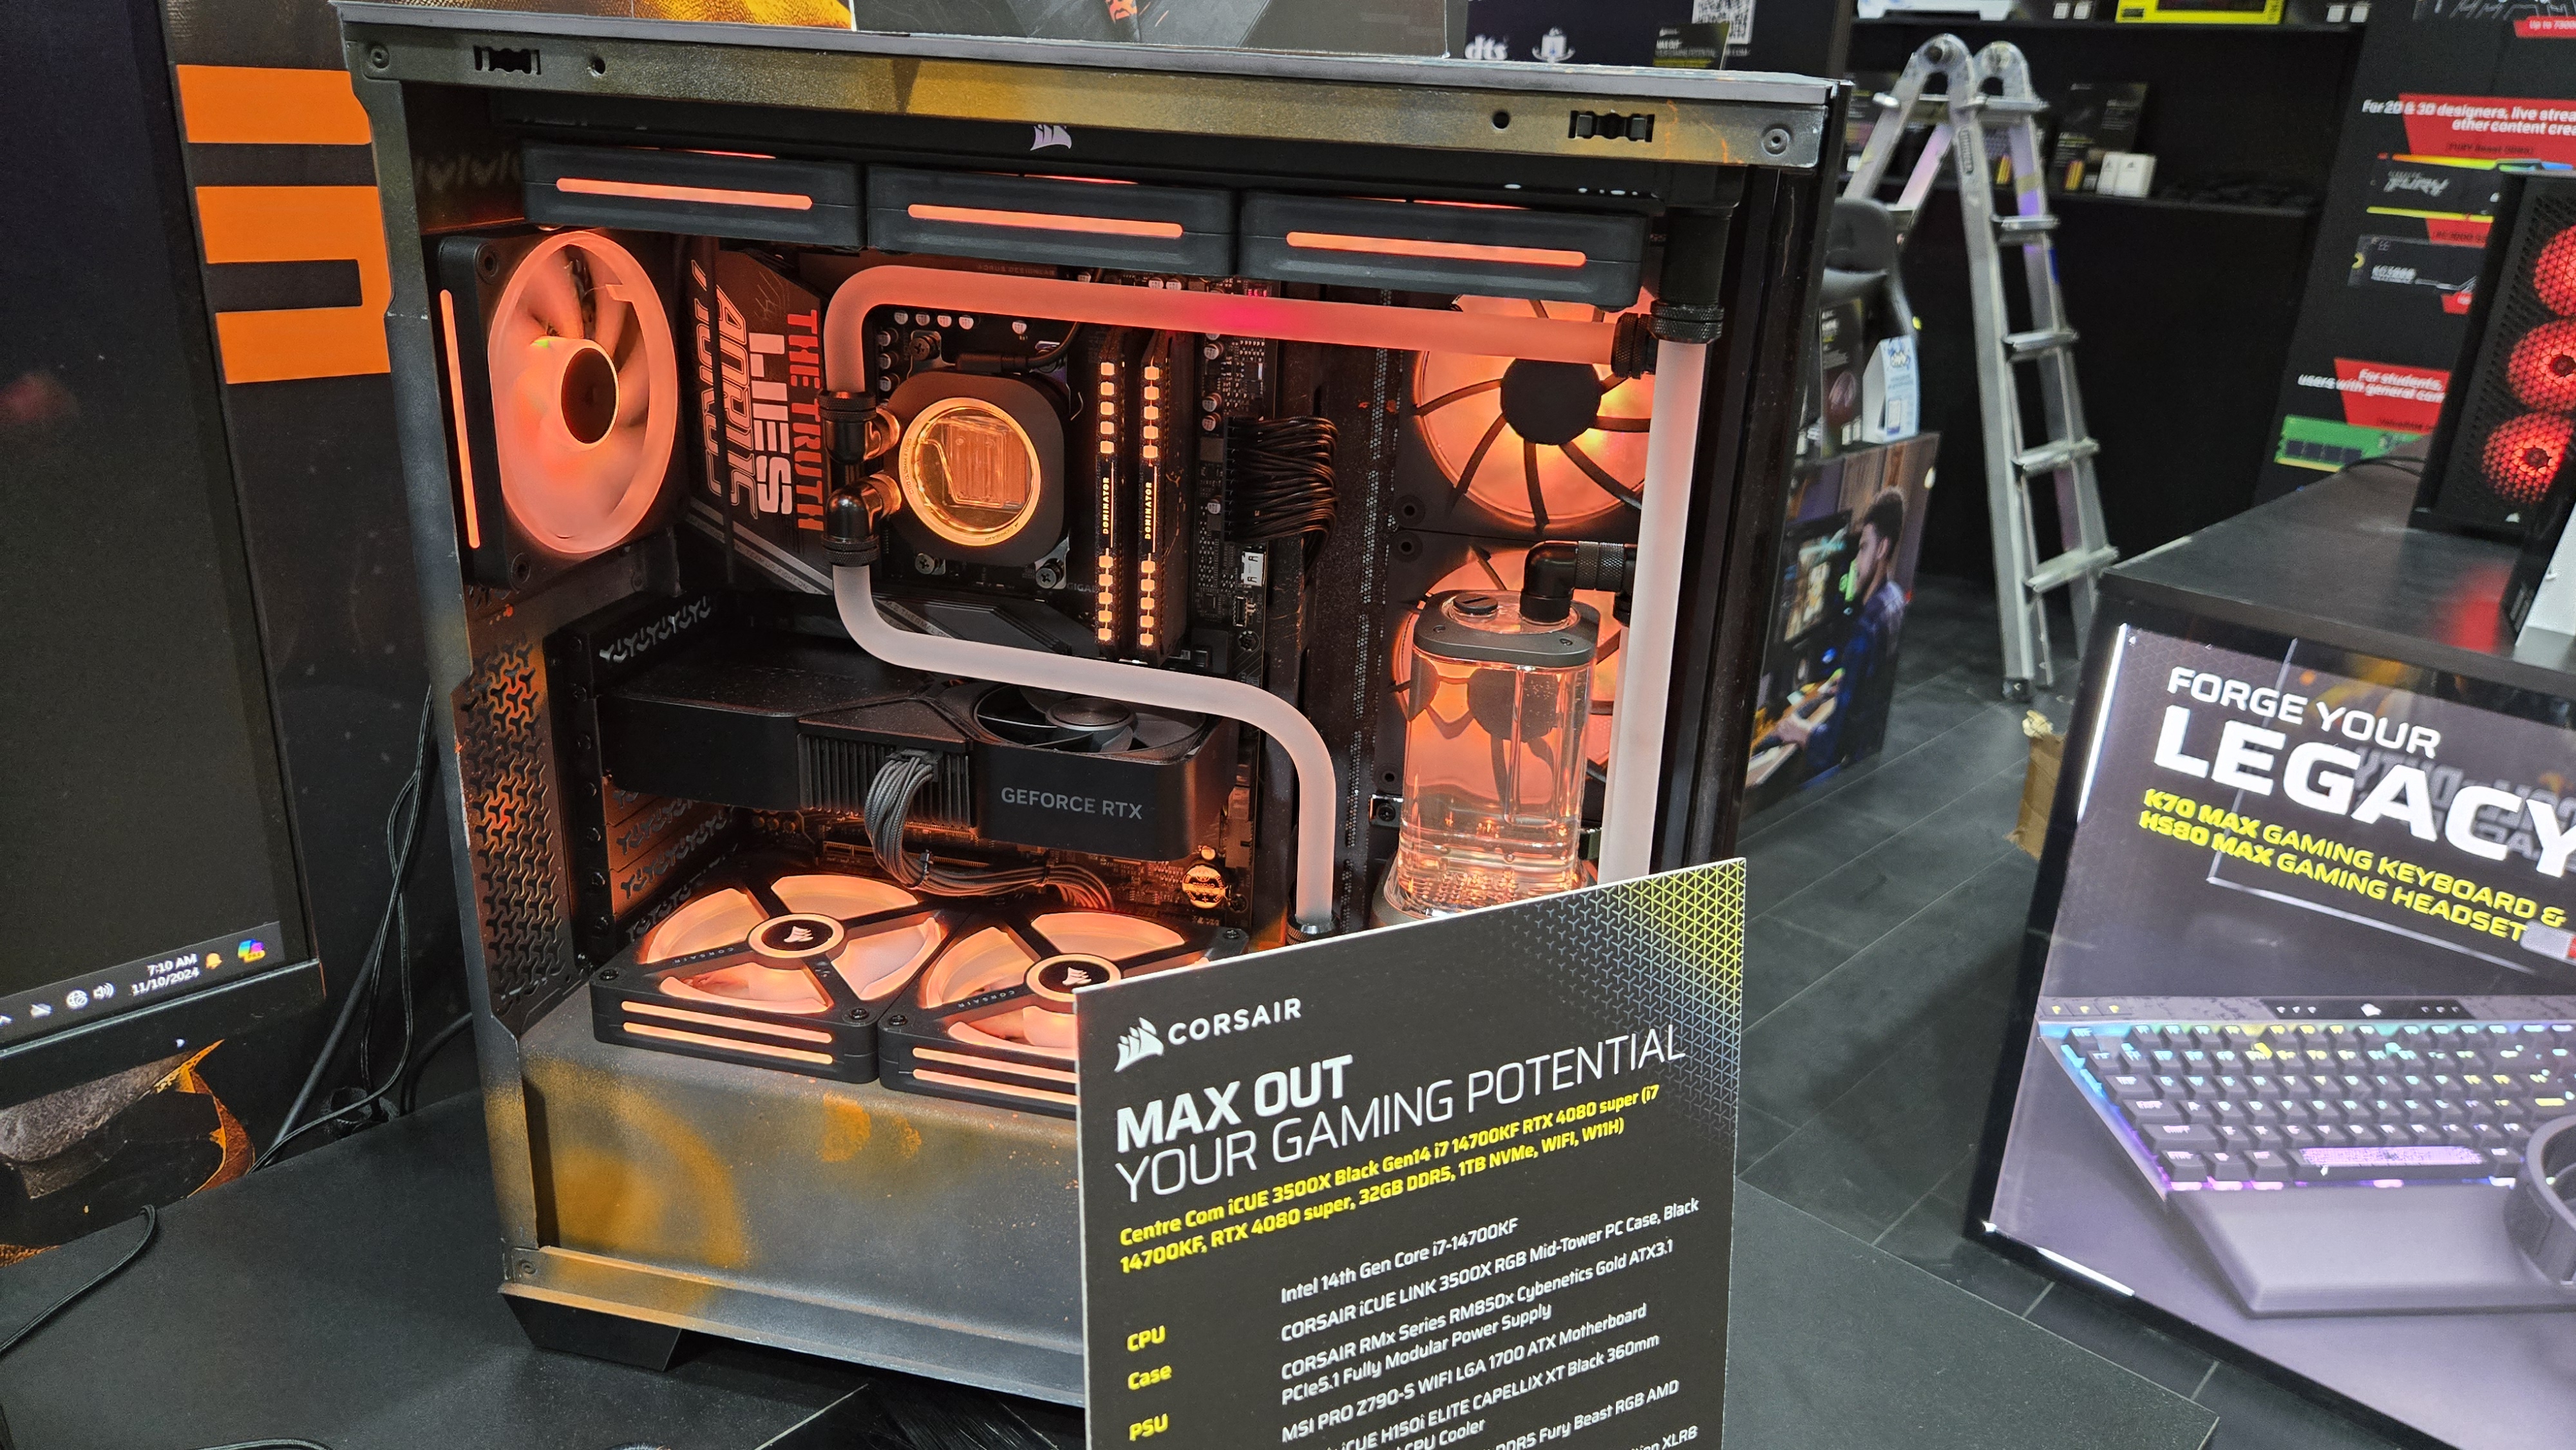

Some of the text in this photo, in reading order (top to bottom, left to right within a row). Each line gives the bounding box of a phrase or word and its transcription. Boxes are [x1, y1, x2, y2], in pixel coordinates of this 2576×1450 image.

[2362, 99, 2384, 114] For
[2511, 105, 2538, 121] live
[2452, 117, 2490, 131] other
[2490, 120, 2548, 135] content
[787, 310, 824, 531] THE TRUTH
[2297, 373, 2336, 390] users
[749, 332, 793, 515] LIES
[985, 527, 1014, 541] CORSAIR
[2167, 666, 2441, 759] FORGE YOUR
[1001, 786, 1143, 821] GEFORCE RTX
[2154, 704, 2576, 878] LEGACY
[2137, 810, 2528, 942] HS80 MAX GAMING HEADSET
[2143, 789, 2567, 928] K70 MAX GAMING KEYBOARD &
[131, 966, 200, 997] 11/10/2024
[147, 953, 198, 977] 7:10 AM
[672, 947, 734, 965] CORSAIR
[958, 990, 1015, 1008] CORSAIR
[1168, 997, 1302, 1046] CORSAIR
[1115, 1024, 1686, 1202] YOUR GAMING POTENTIAL
[1117, 1053, 1353, 1153] MAX OUT
[1120, 1084, 1660, 1247] Centre Com iCUE 3500X Black Gen14 i7 14700KF RTX 4080 super (i7
[1120, 1116, 1625, 1274] 14700KF, RTX 4080 super, 32GB DDR5, 1TB NVMe, WIFI, W11H)
[1281, 1217, 1519, 1304] Intel 14th Gen Core i7-14700KF
[1281, 1197, 1700, 1342] CORSAIR iCUE LINK 3500X RGB Mid-Tower PC Case, Black
[1127, 1324, 1166, 1352] CPU
[1281, 1239, 1674, 1380] CORSAIR RMx Series RM850x Cybenetics Gold ATX3.1
[1128, 1365, 1172, 1391] Case
[1282, 1302, 1553, 1406] PCIe5.1 Fully Modular Power Supply
[1282, 1302, 1648, 1443] MSI PRO Z790-S WIFI LGA 1700 ATX Motherboard
[1381, 1413, 1426, 1444] H150i
[1428, 1398, 1471, 1427] ELITE
[1472, 1371, 1544, 1411] CAPELLIX
[1545, 1364, 1566, 1385] XT
[1567, 1351, 1605, 1377] Black
[1606, 1334, 1661, 1364] 360mm
[1129, 1413, 1169, 1442] PSU
[1404, 1418, 1486, 1450] CPU Cooler
[1495, 1379, 1680, 1450] DDR5 Fury Beast RGB AMD
[1662, 1425, 1699, 1450] XLR8
